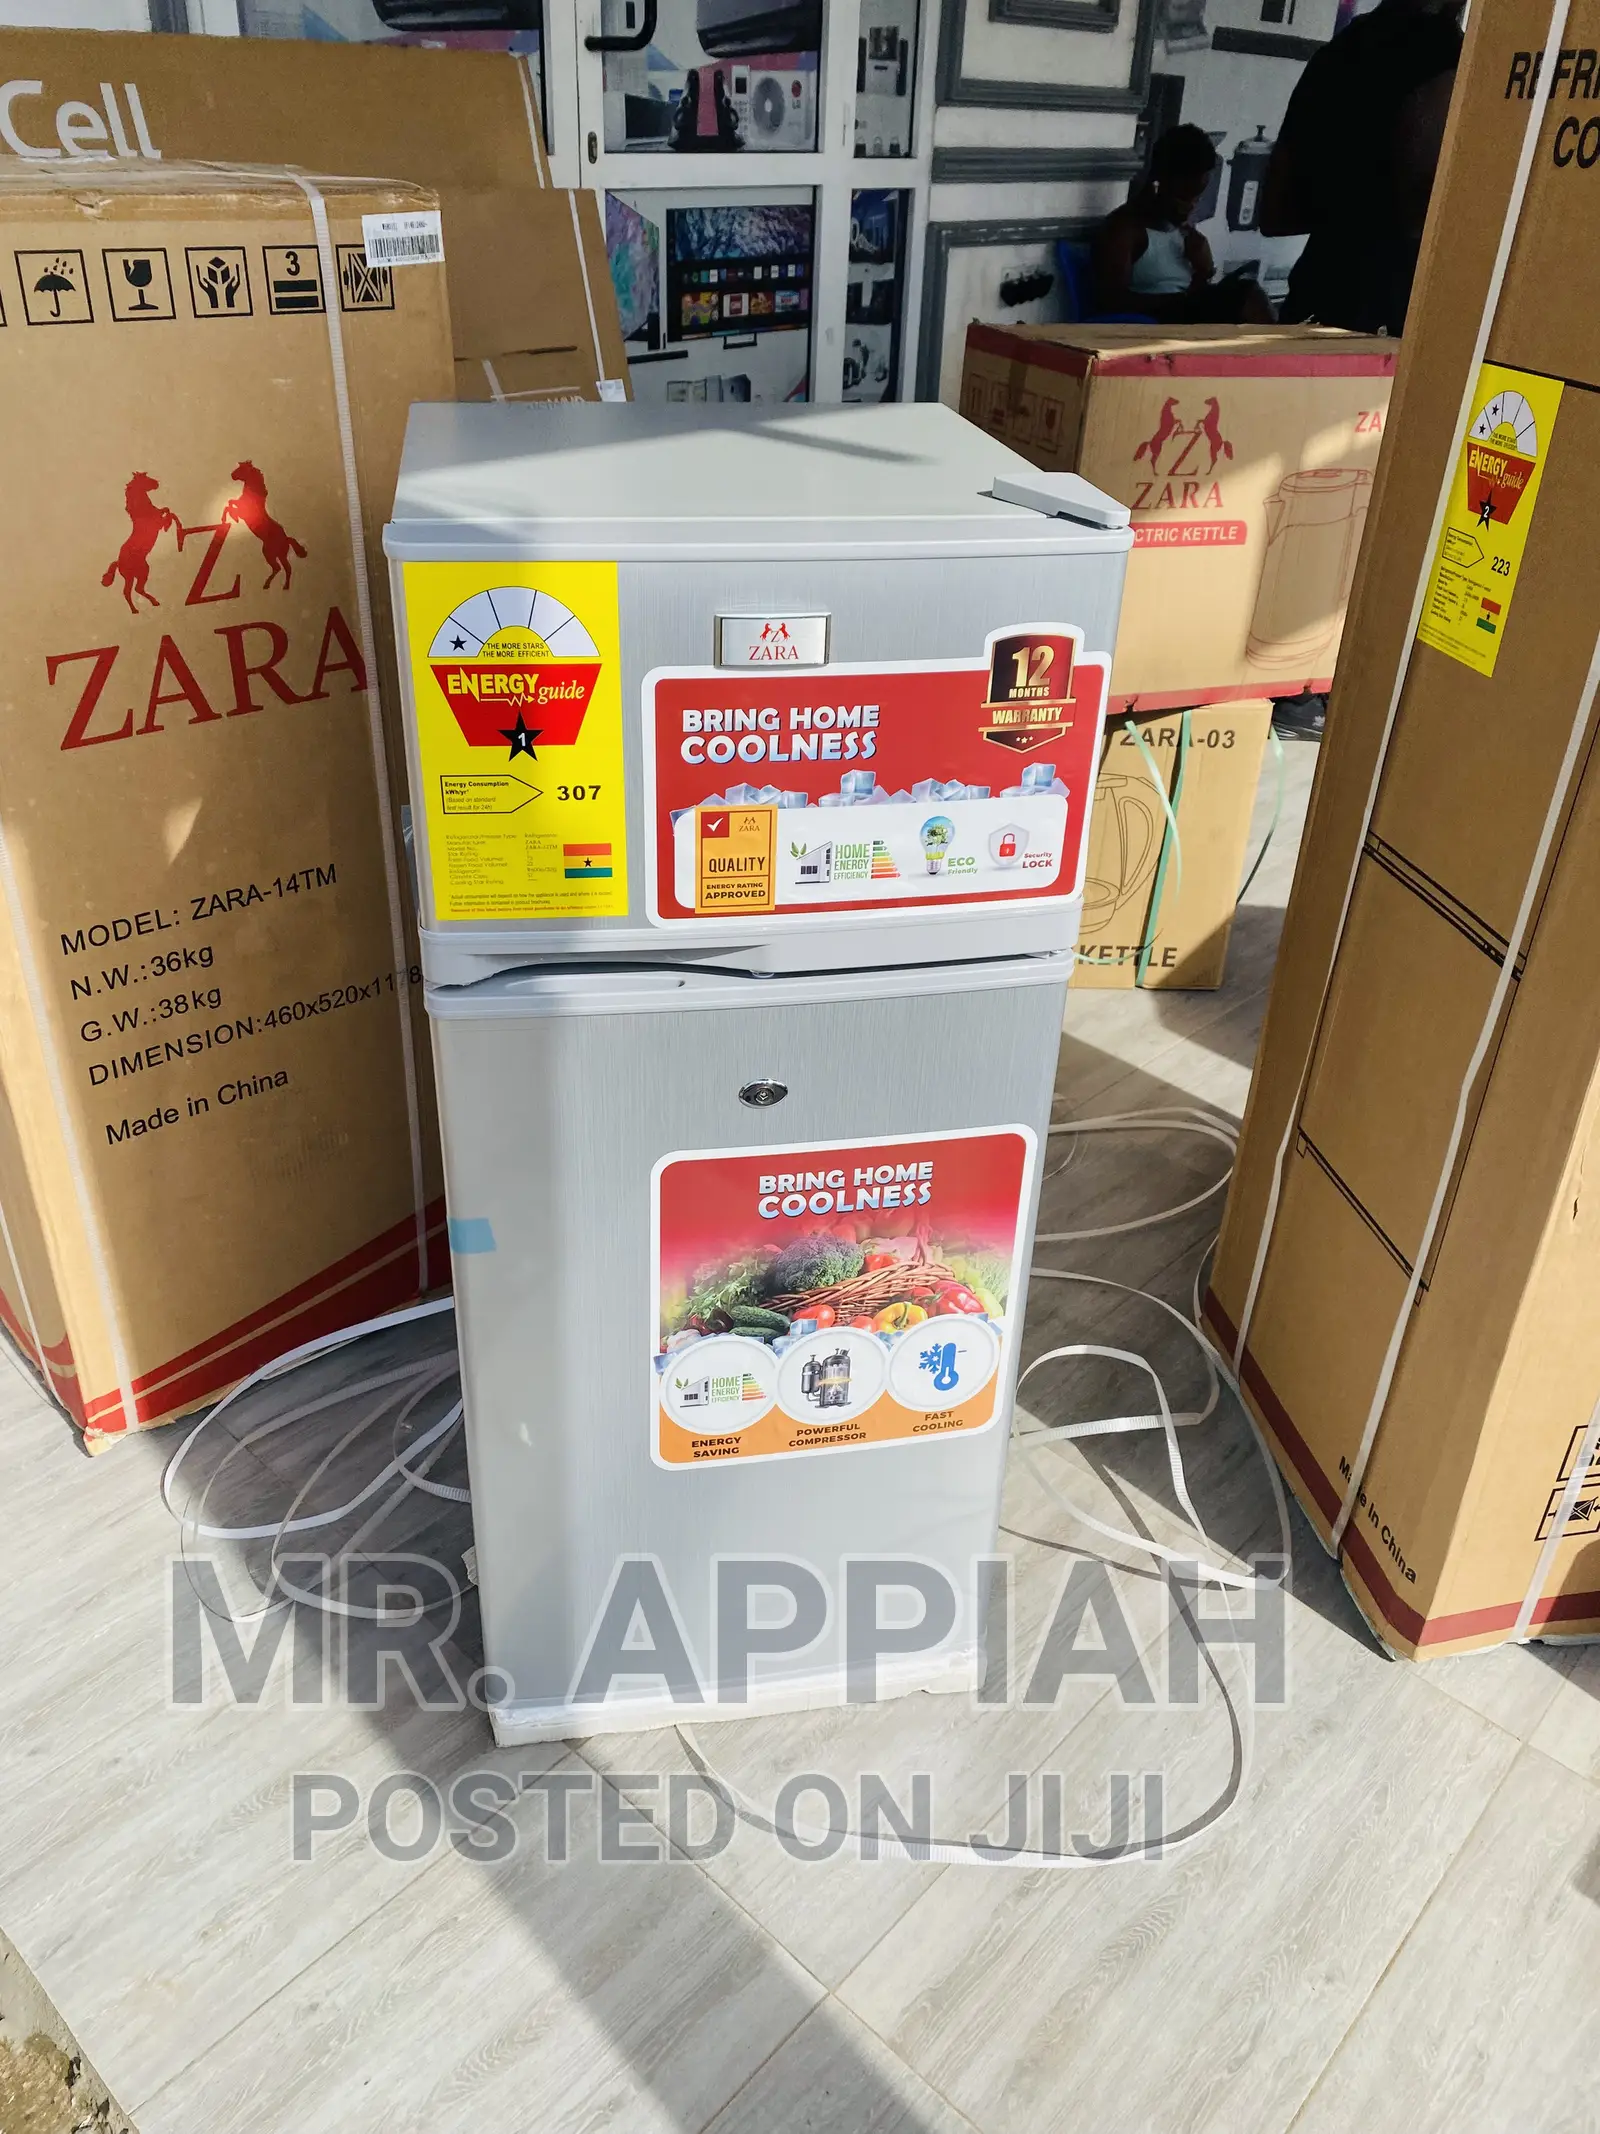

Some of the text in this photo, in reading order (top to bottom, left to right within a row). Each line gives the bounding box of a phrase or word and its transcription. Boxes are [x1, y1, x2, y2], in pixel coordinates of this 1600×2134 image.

[0, 80, 162, 160] Cell
[285, 251, 300, 276] 3
[1354, 411, 1383, 432] ZA
[1469, 446, 1524, 489] ENERGY guide
[1131, 481, 1224, 510] ZARA
[1483, 505, 1490, 518] 2
[1182, 525, 1239, 541] KETTLE
[1491, 556, 1511, 577] 223
[748, 645, 799, 661] ZARA
[1012, 645, 1055, 687] 12
[47, 606, 373, 752] ZARA
[447, 667, 585, 704] ENERGY guide
[1009, 687, 1050, 698] MONTHS
[682, 704, 880, 733] BRING HOME
[992, 707, 1063, 724] WARRANTY
[518, 732, 527, 747] 1
[680, 731, 877, 764] COOLNESS
[557, 785, 602, 801] 307
[835, 844, 870, 859] HOME
[709, 857, 765, 873] QUALITY
[834, 859, 869, 871] ENERGY
[948, 857, 975, 867] ECO
[1022, 859, 1053, 869] LOCK
[833, 871, 868, 880] EFFICIENCY
[947, 867, 978, 875] Friendly
[705, 890, 766, 899] APPROVED
[60, 864, 337, 955] MODEL: ZARA-14TM
[1078, 945, 1178, 968] KETTLE
[89, 965, 422, 1085] DIMENSION:460x520x118
[105, 1070, 289, 1145] Made in China
[759, 1161, 933, 1195] BRING HOME
[758, 1181, 932, 1219] COOLNESS
[711, 1376, 741, 1388] HOME
[711, 1387, 740, 1397] ENERGY
[924, 1410, 954, 1421] FAST
[796, 1423, 861, 1437] POWERFUL
[912, 1419, 964, 1433] COOLING
[691, 1437, 742, 1448] ENERGY
[788, 1432, 867, 1447] COMPRESSOR
[693, 1447, 740, 1458] SAVING
[1339, 1456, 1367, 1507] Me
[1381, 1525, 1416, 1584] China
